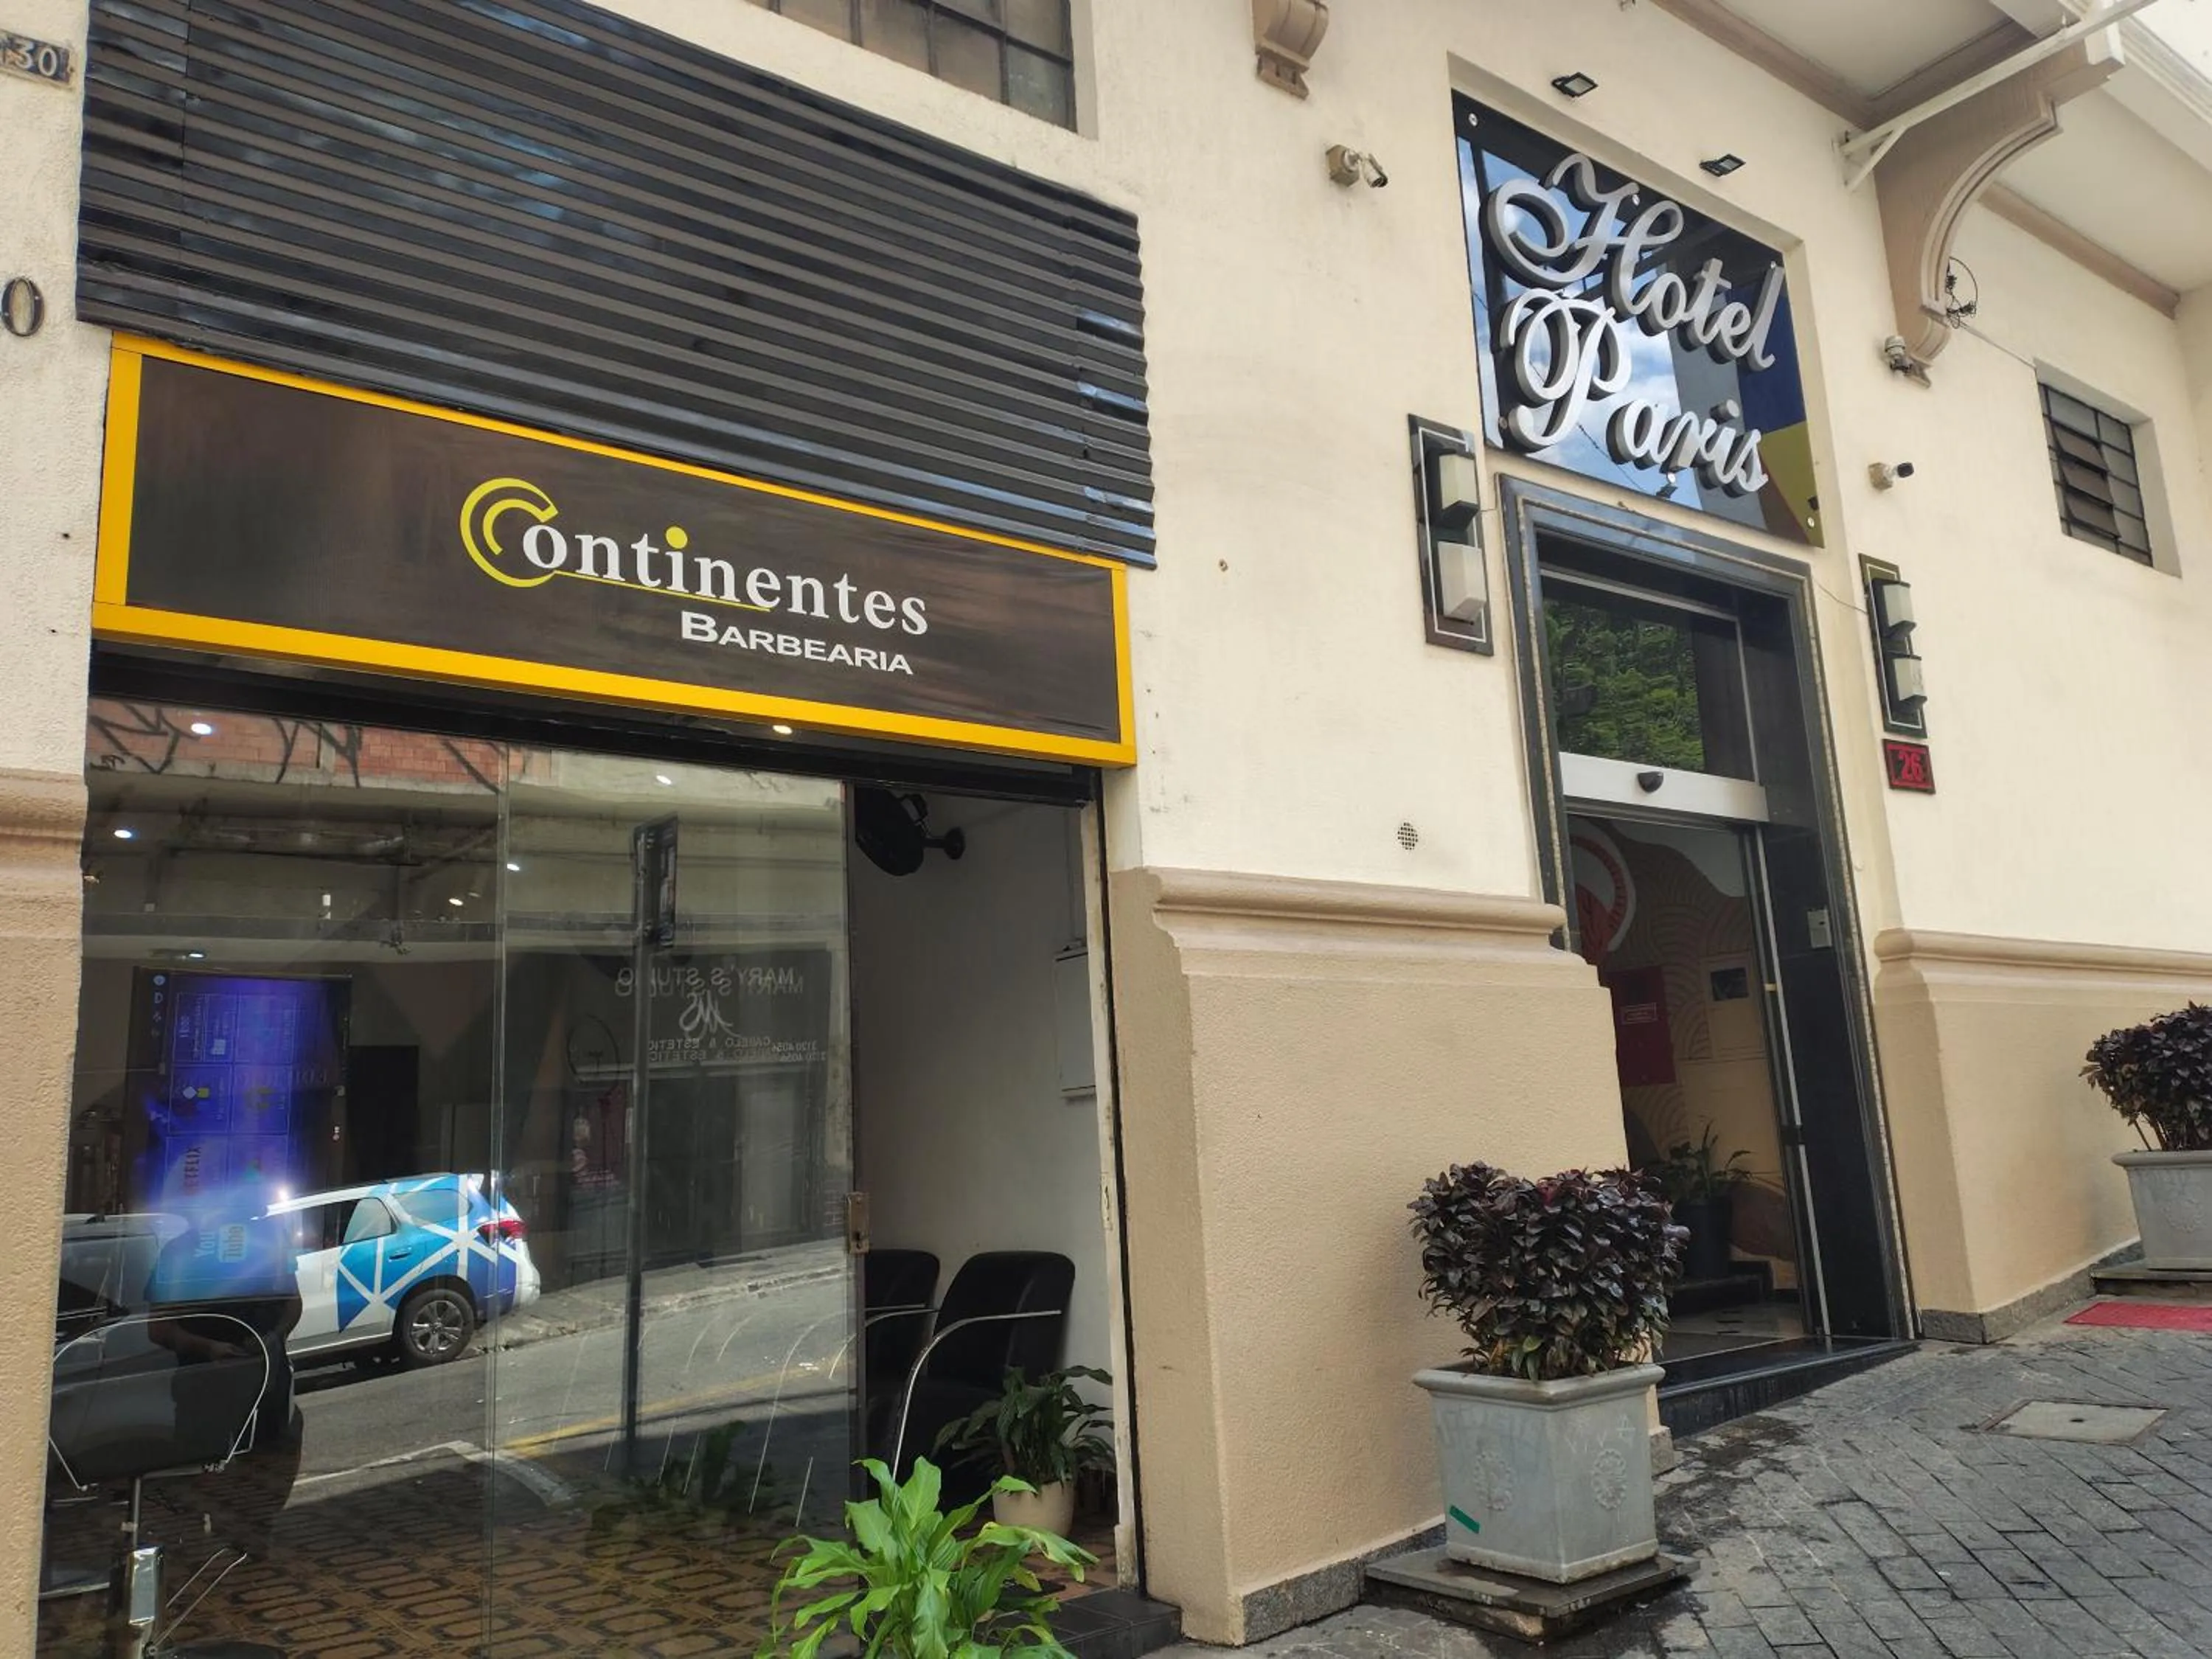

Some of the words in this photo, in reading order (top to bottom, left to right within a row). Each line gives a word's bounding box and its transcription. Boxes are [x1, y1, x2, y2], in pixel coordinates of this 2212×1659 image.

[1484, 152, 1784, 372] Hotel
[1497, 288, 1769, 497] Paris
[459, 476, 930, 636] Continentes
[680, 610, 914, 675] BARBEARIA
[194, 1231, 216, 1258] You
